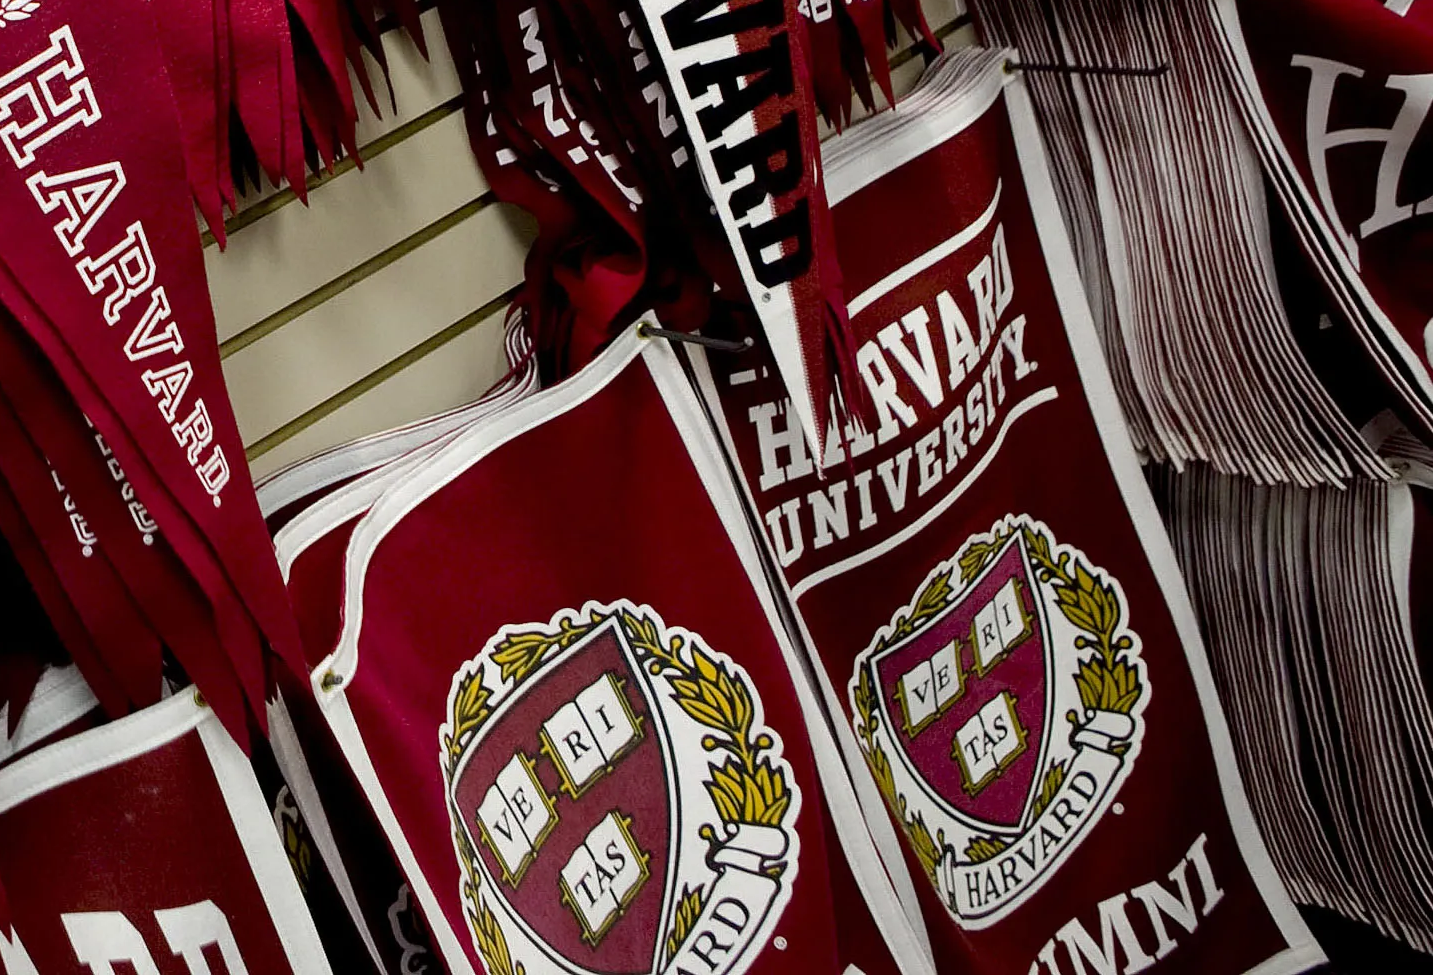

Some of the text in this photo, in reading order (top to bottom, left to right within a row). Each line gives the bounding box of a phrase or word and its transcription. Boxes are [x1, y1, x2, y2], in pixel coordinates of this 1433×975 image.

[964, 714, 1009, 765] TAS
[574, 839, 628, 910] TAS
[966, 768, 1099, 910] HARVARD
